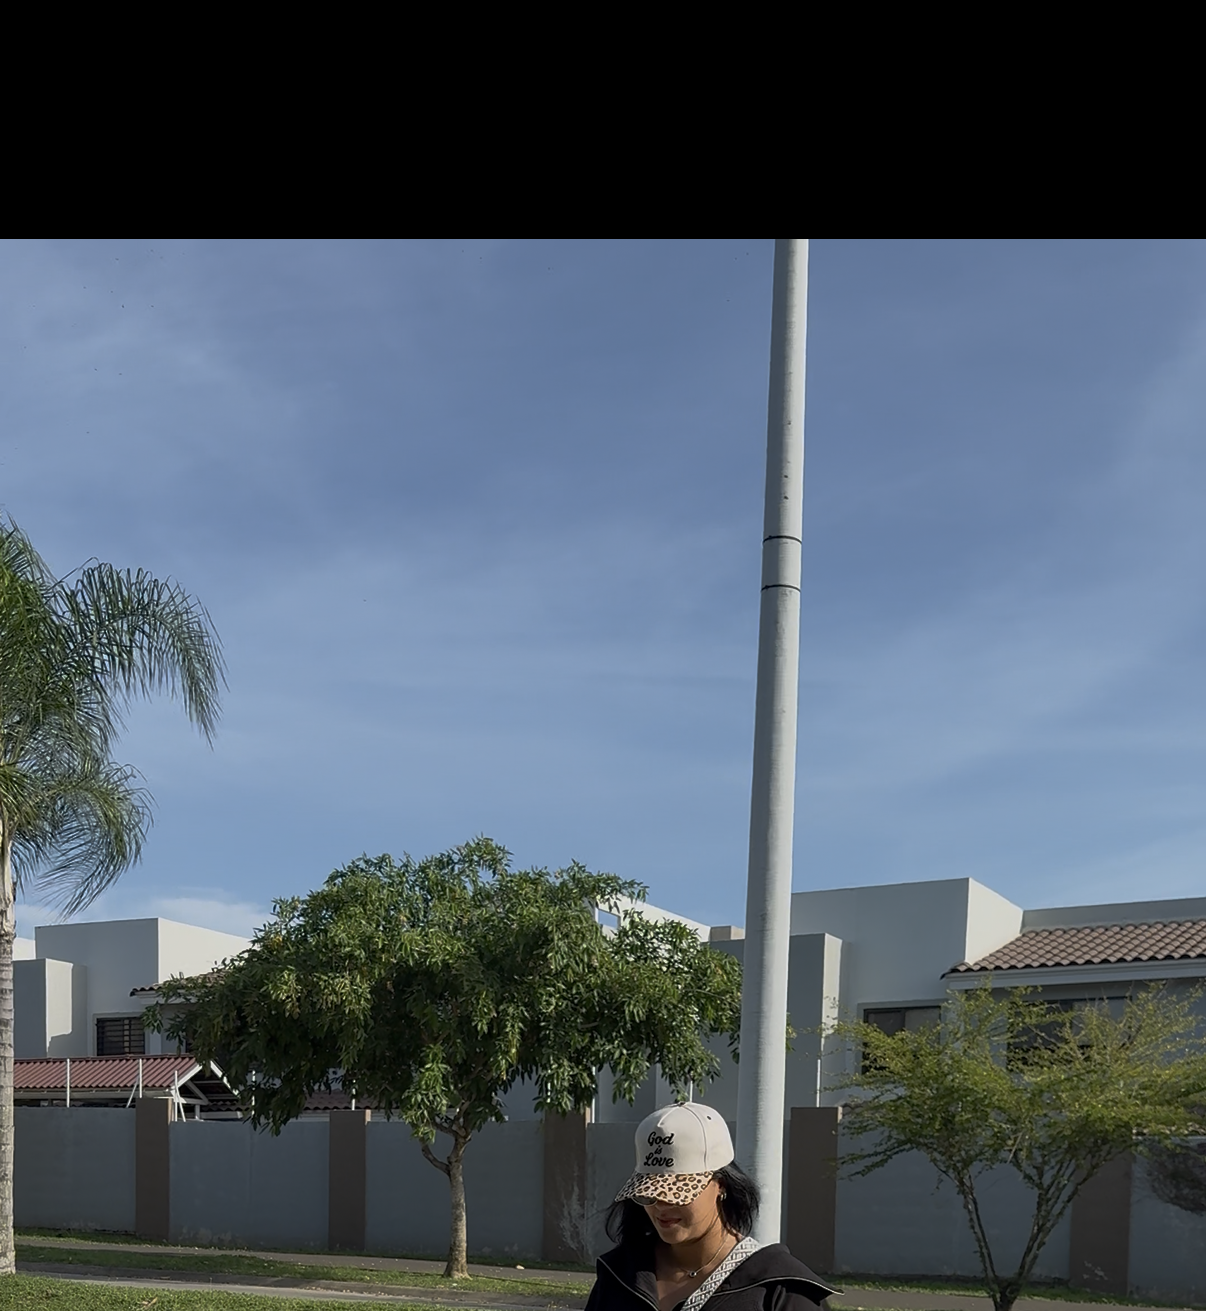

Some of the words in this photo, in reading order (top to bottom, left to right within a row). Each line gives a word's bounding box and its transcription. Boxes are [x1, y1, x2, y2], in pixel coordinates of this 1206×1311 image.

[647, 1131, 674, 1146] God
[654, 1145, 663, 1155] is
[643, 1152, 674, 1167] Love
